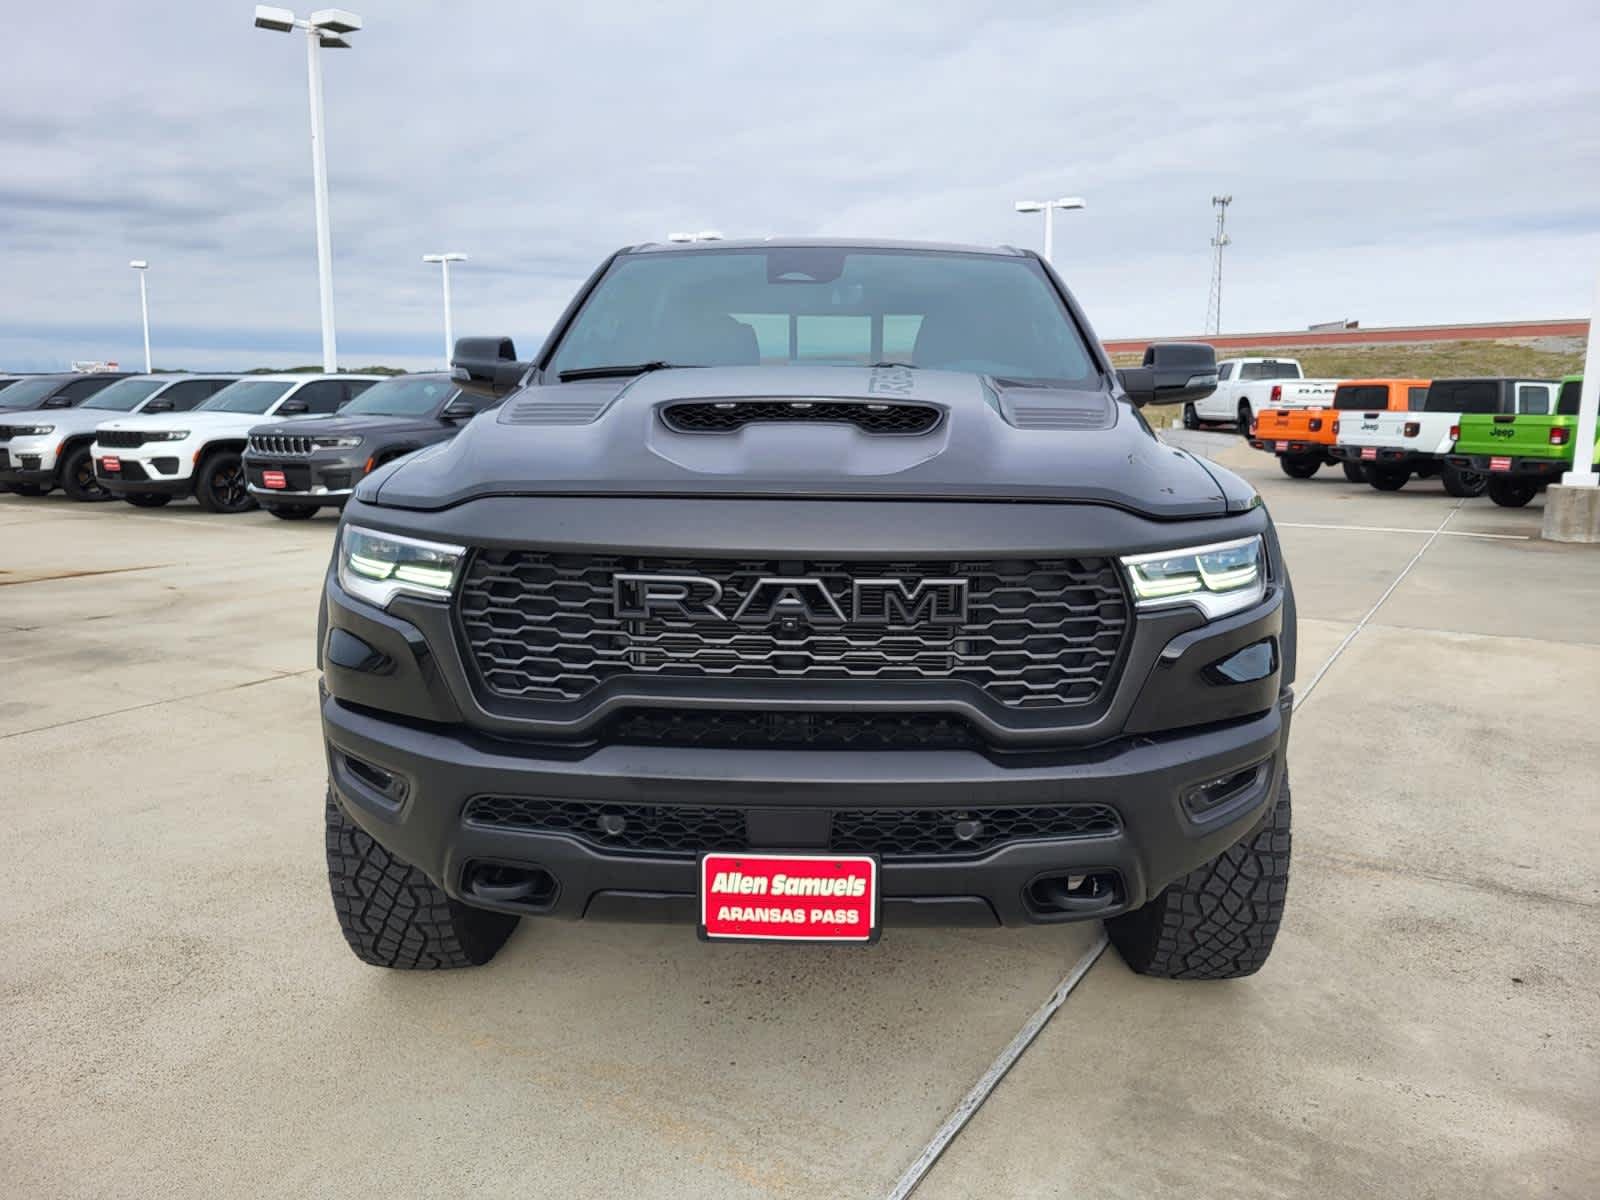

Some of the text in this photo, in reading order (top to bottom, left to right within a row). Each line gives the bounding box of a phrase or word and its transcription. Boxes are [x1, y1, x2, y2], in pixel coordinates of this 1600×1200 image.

[1361, 422, 1380, 431] Jeep
[1489, 426, 1515, 438] Jeep
[613, 573, 969, 623] RAM
[711, 872, 867, 897] Allen Samuels
[717, 906, 860, 924] ARANSAS PASS
